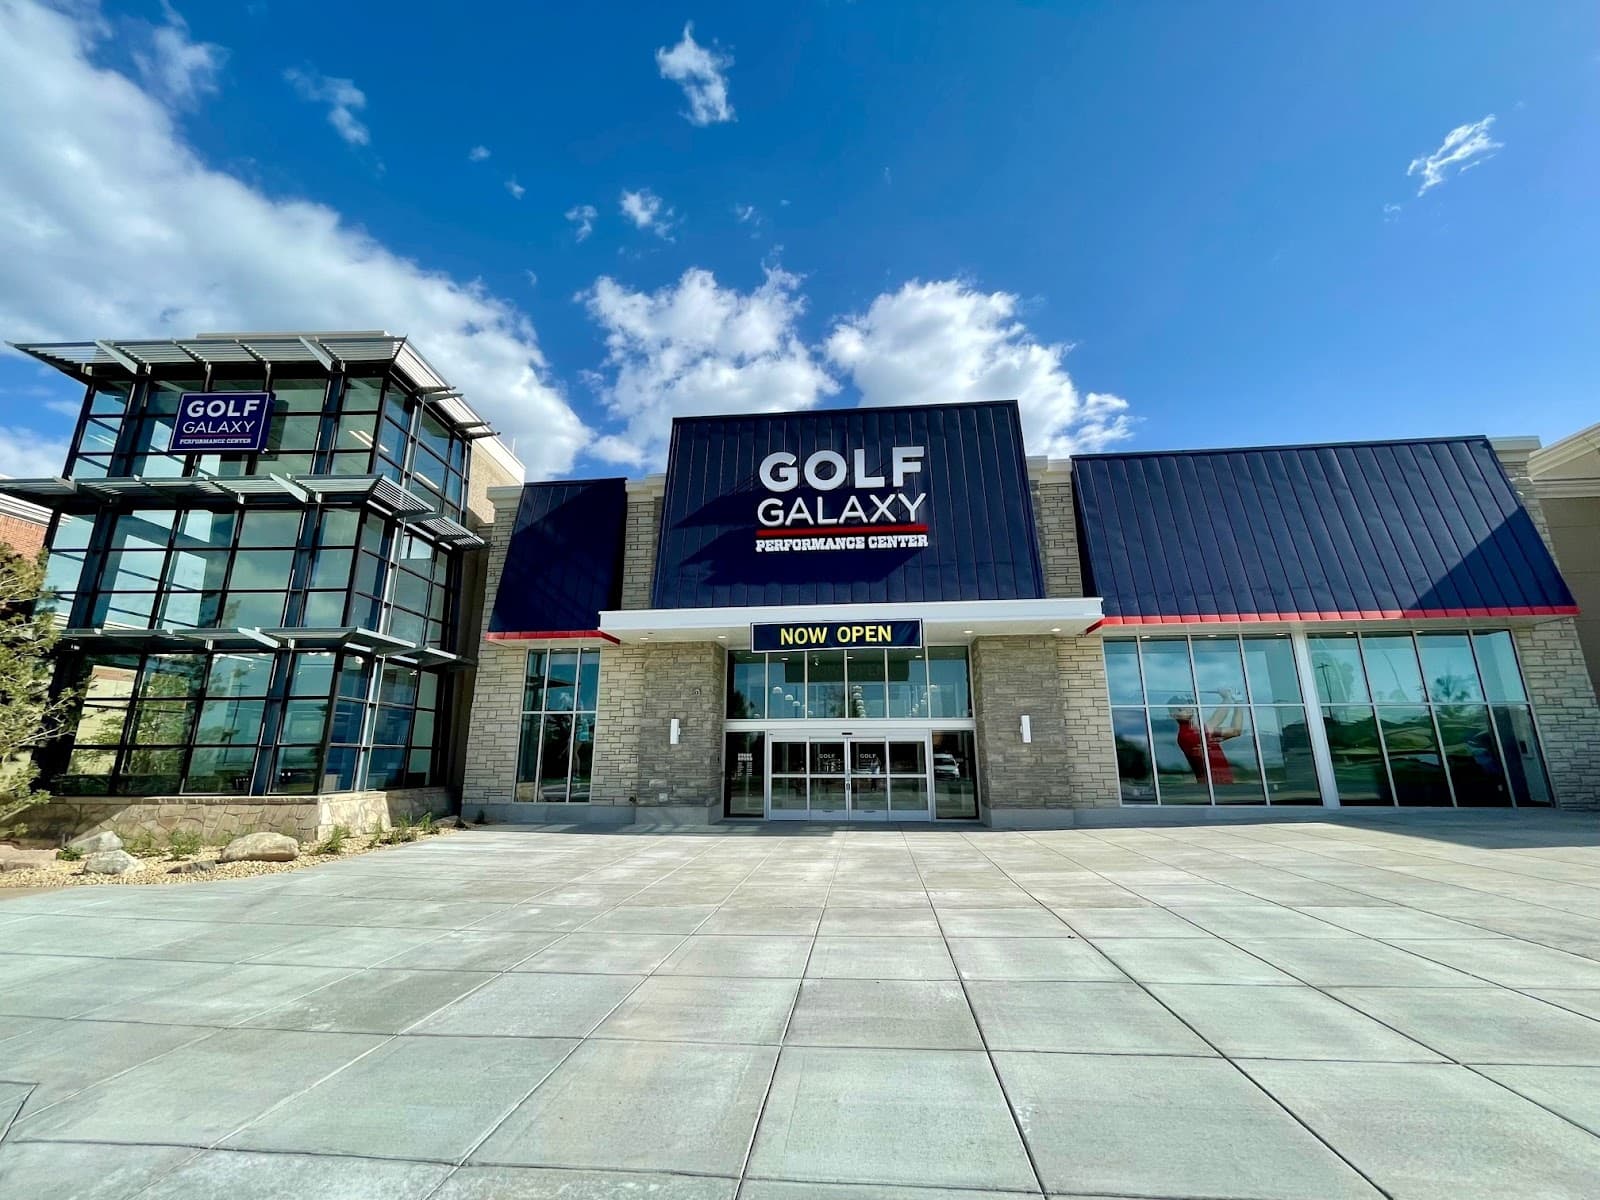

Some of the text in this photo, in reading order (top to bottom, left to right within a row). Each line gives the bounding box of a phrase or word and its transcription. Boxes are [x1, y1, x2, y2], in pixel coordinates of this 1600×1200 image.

[187, 400, 260, 417] GOLF
[183, 421, 255, 434] GALAXY
[759, 446, 925, 492] GOLF
[757, 493, 927, 526] GALAXY
[755, 534, 929, 552] PERFORMANCE CENTER
[780, 625, 893, 645] NOW OPEN
